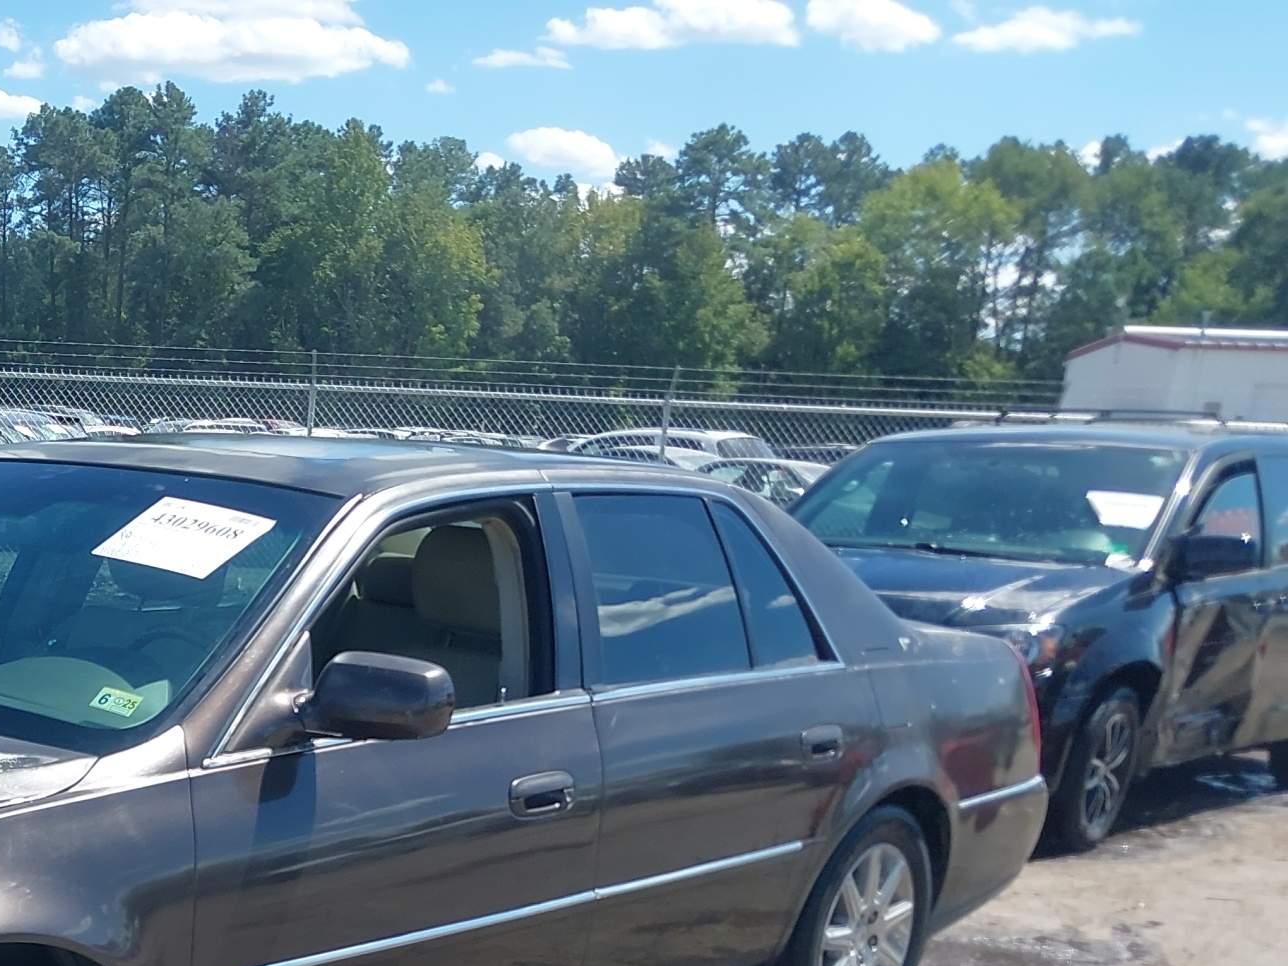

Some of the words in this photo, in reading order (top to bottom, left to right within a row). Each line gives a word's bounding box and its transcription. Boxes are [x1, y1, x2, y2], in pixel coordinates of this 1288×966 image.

[152, 512, 244, 540] 43029608
[98, 693, 112, 705] 6
[122, 699, 138, 710] 25
